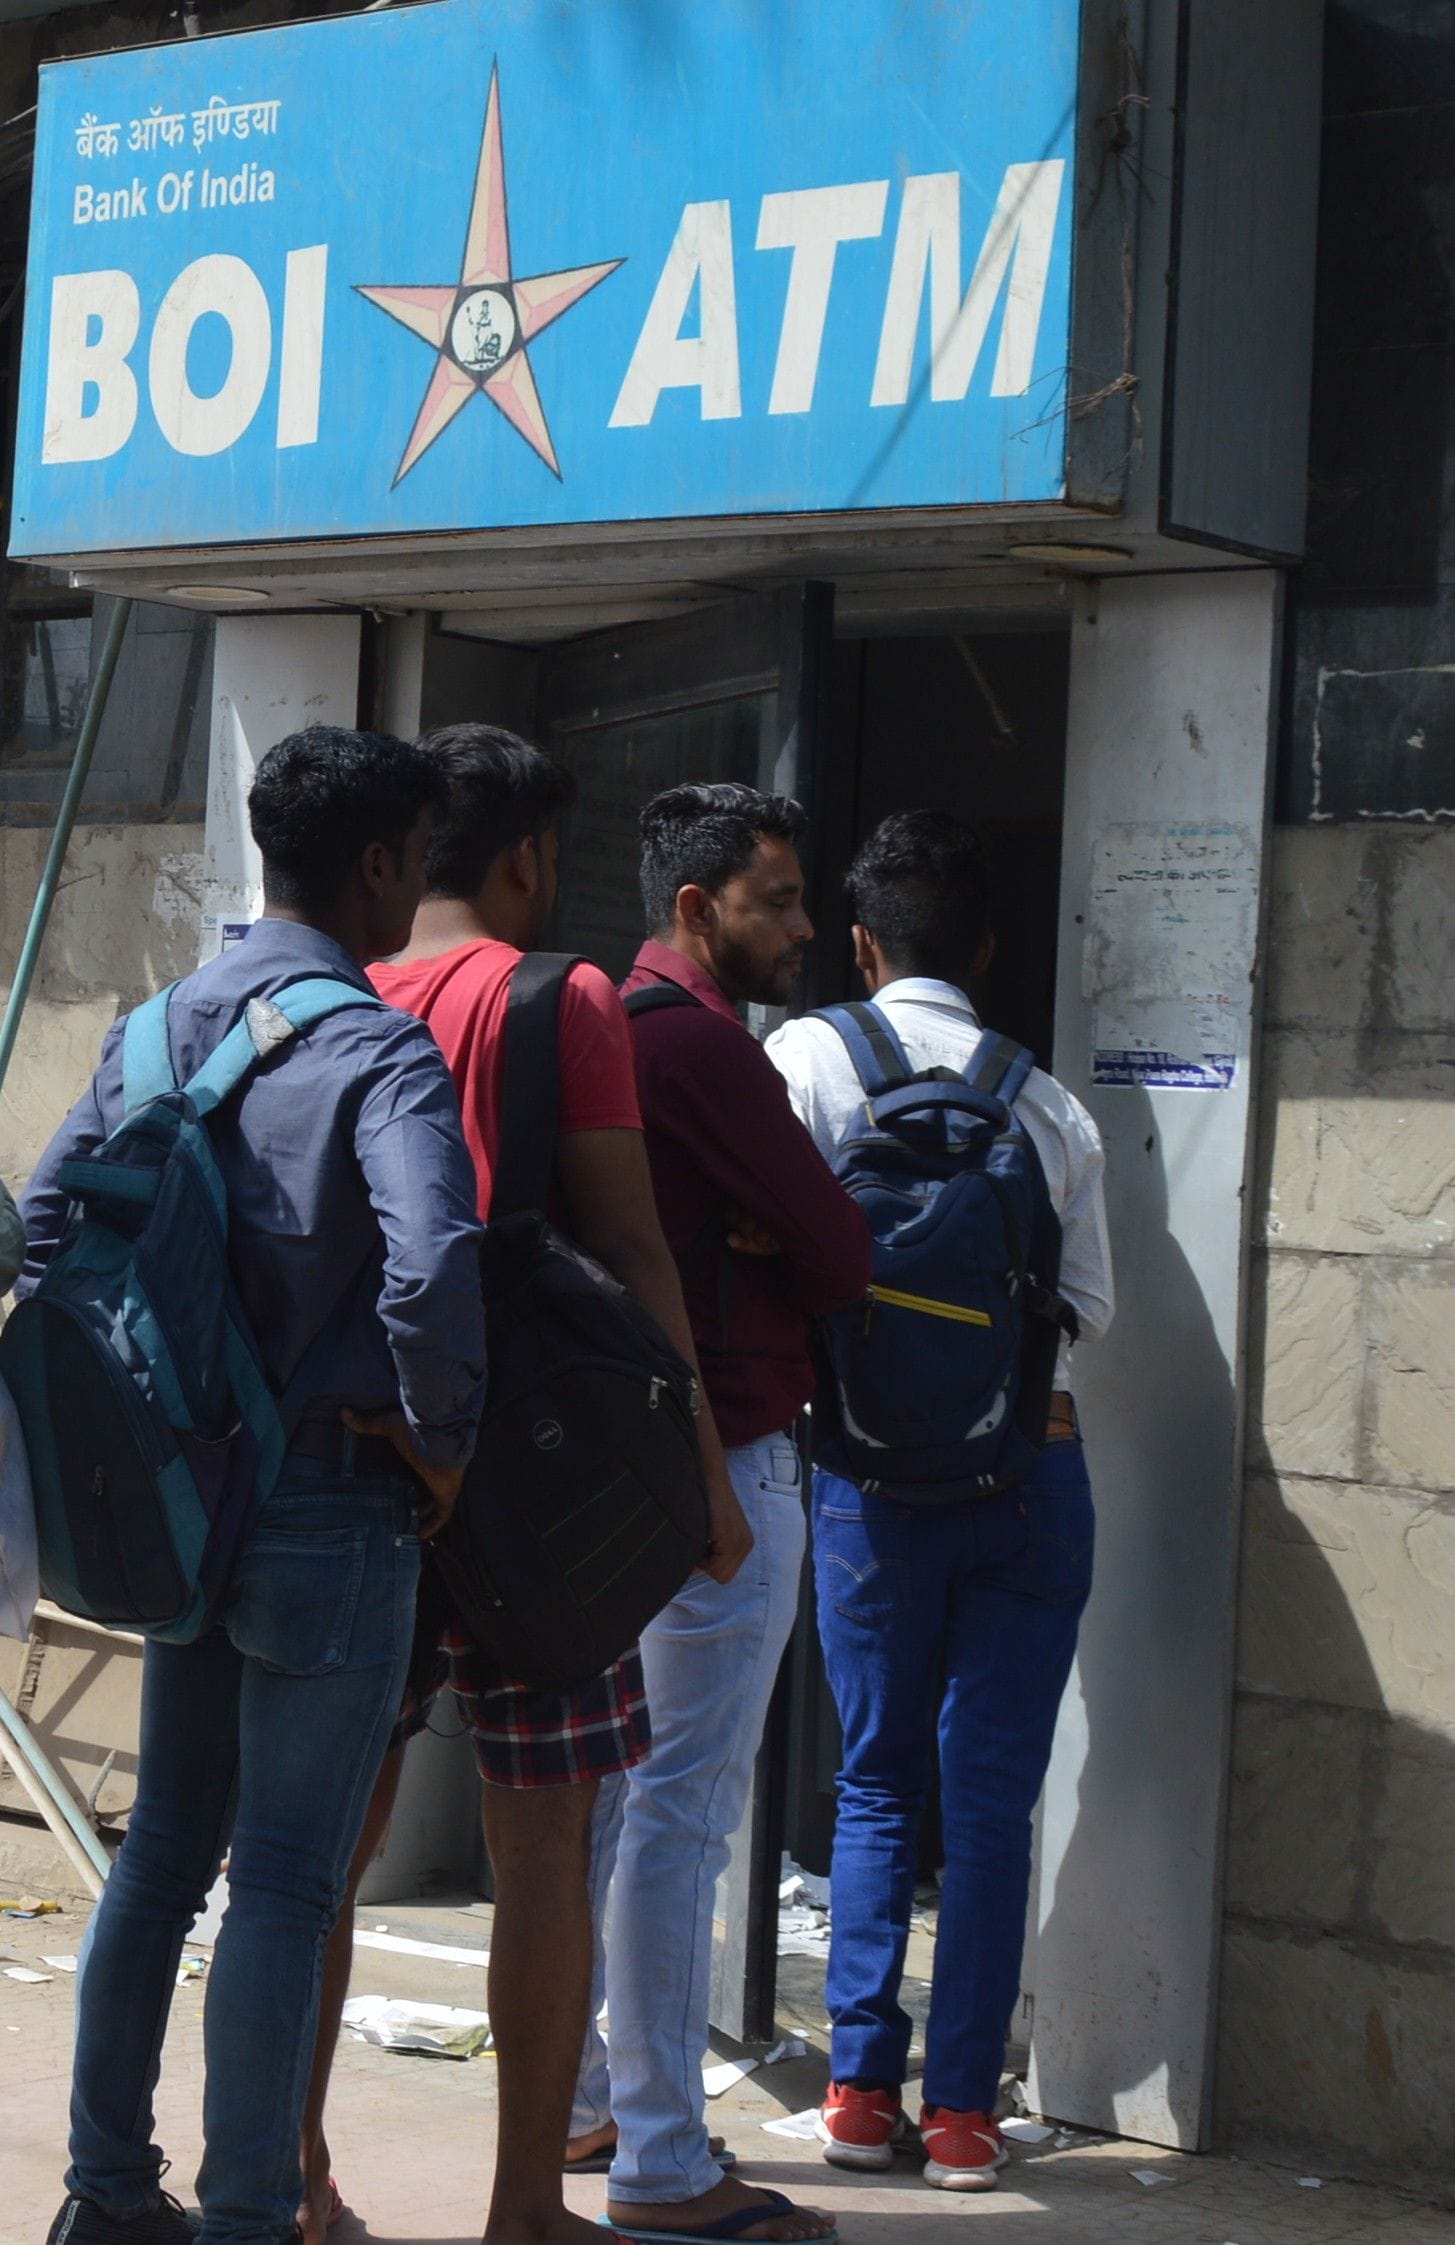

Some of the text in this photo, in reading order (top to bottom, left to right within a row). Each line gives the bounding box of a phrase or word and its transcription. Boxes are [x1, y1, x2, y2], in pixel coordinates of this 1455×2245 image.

[75, 95, 282, 159] बैंक ऑफ इण्डिया
[73, 162, 275, 225] Bank Of India
[41, 158, 1065, 464] BOI ATM
